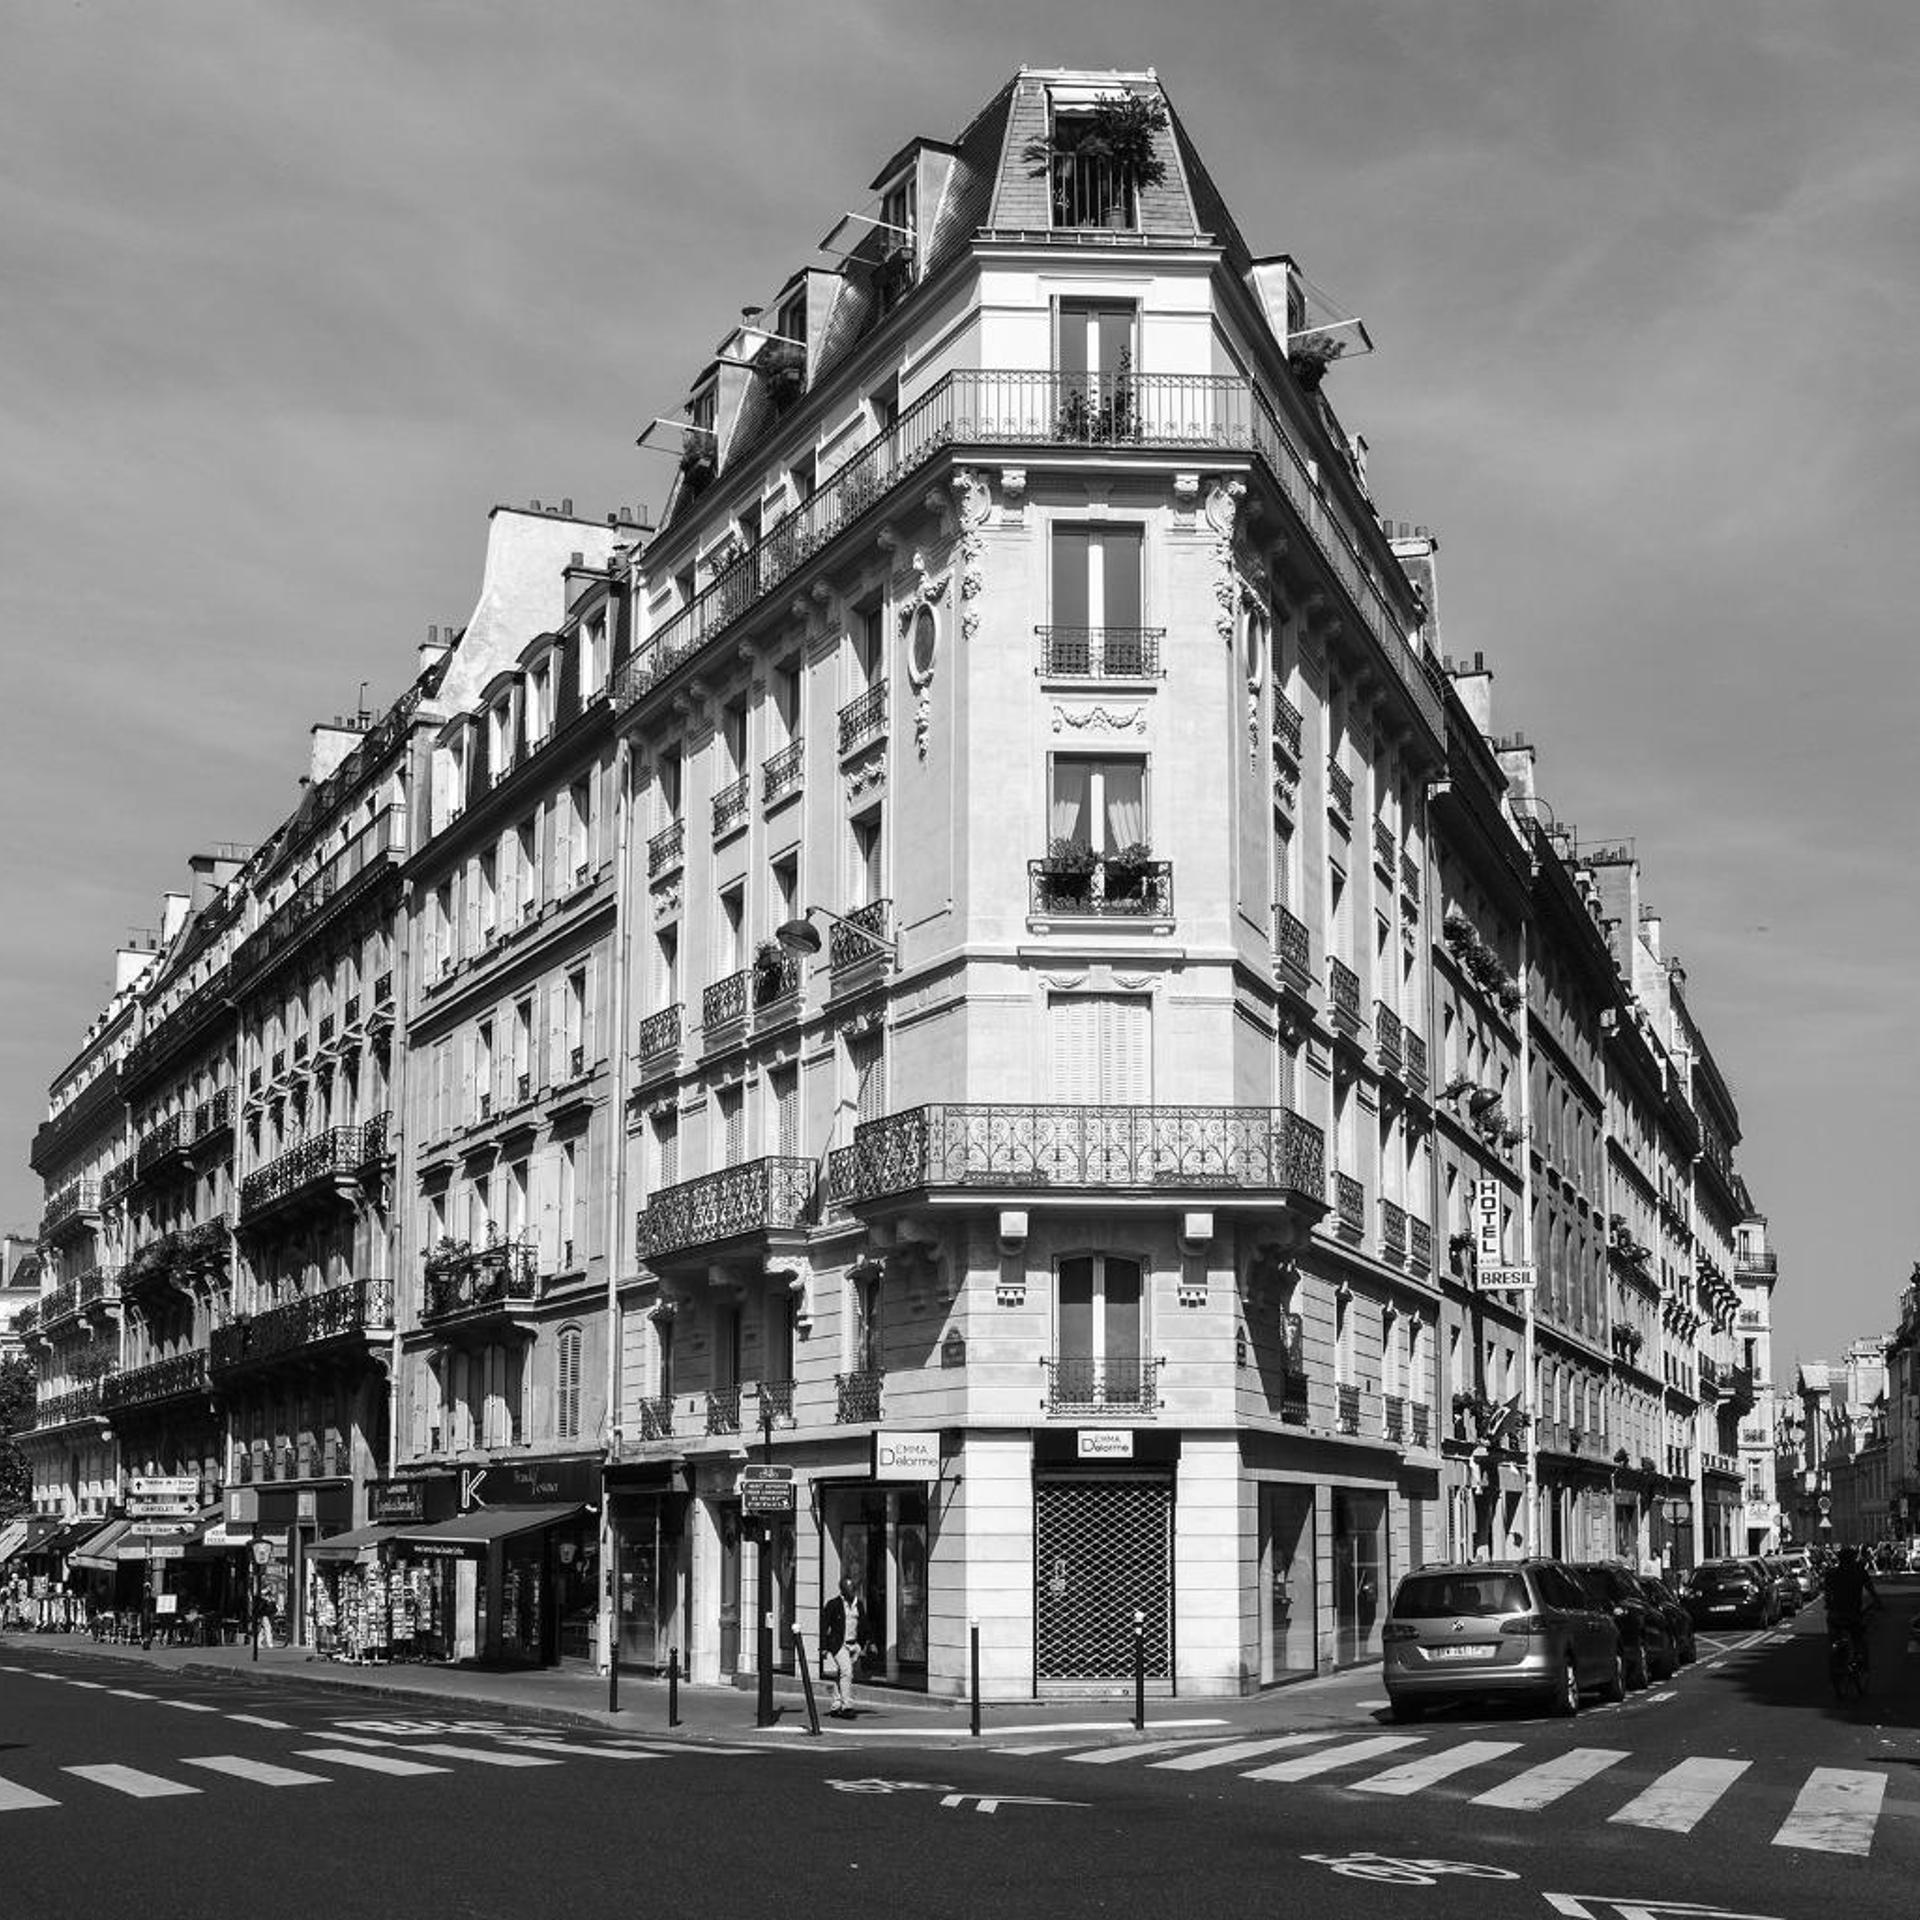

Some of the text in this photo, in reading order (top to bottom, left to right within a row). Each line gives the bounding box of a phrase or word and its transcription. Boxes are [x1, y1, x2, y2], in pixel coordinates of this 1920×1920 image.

[1480, 1181, 1497, 1254] HOTEL
[1481, 1271, 1535, 1285] BRESIL
[896, 1444, 928, 1454] EMMA
[1081, 1438, 1129, 1452] Delorme
[879, 1447, 938, 1467] Delorme
